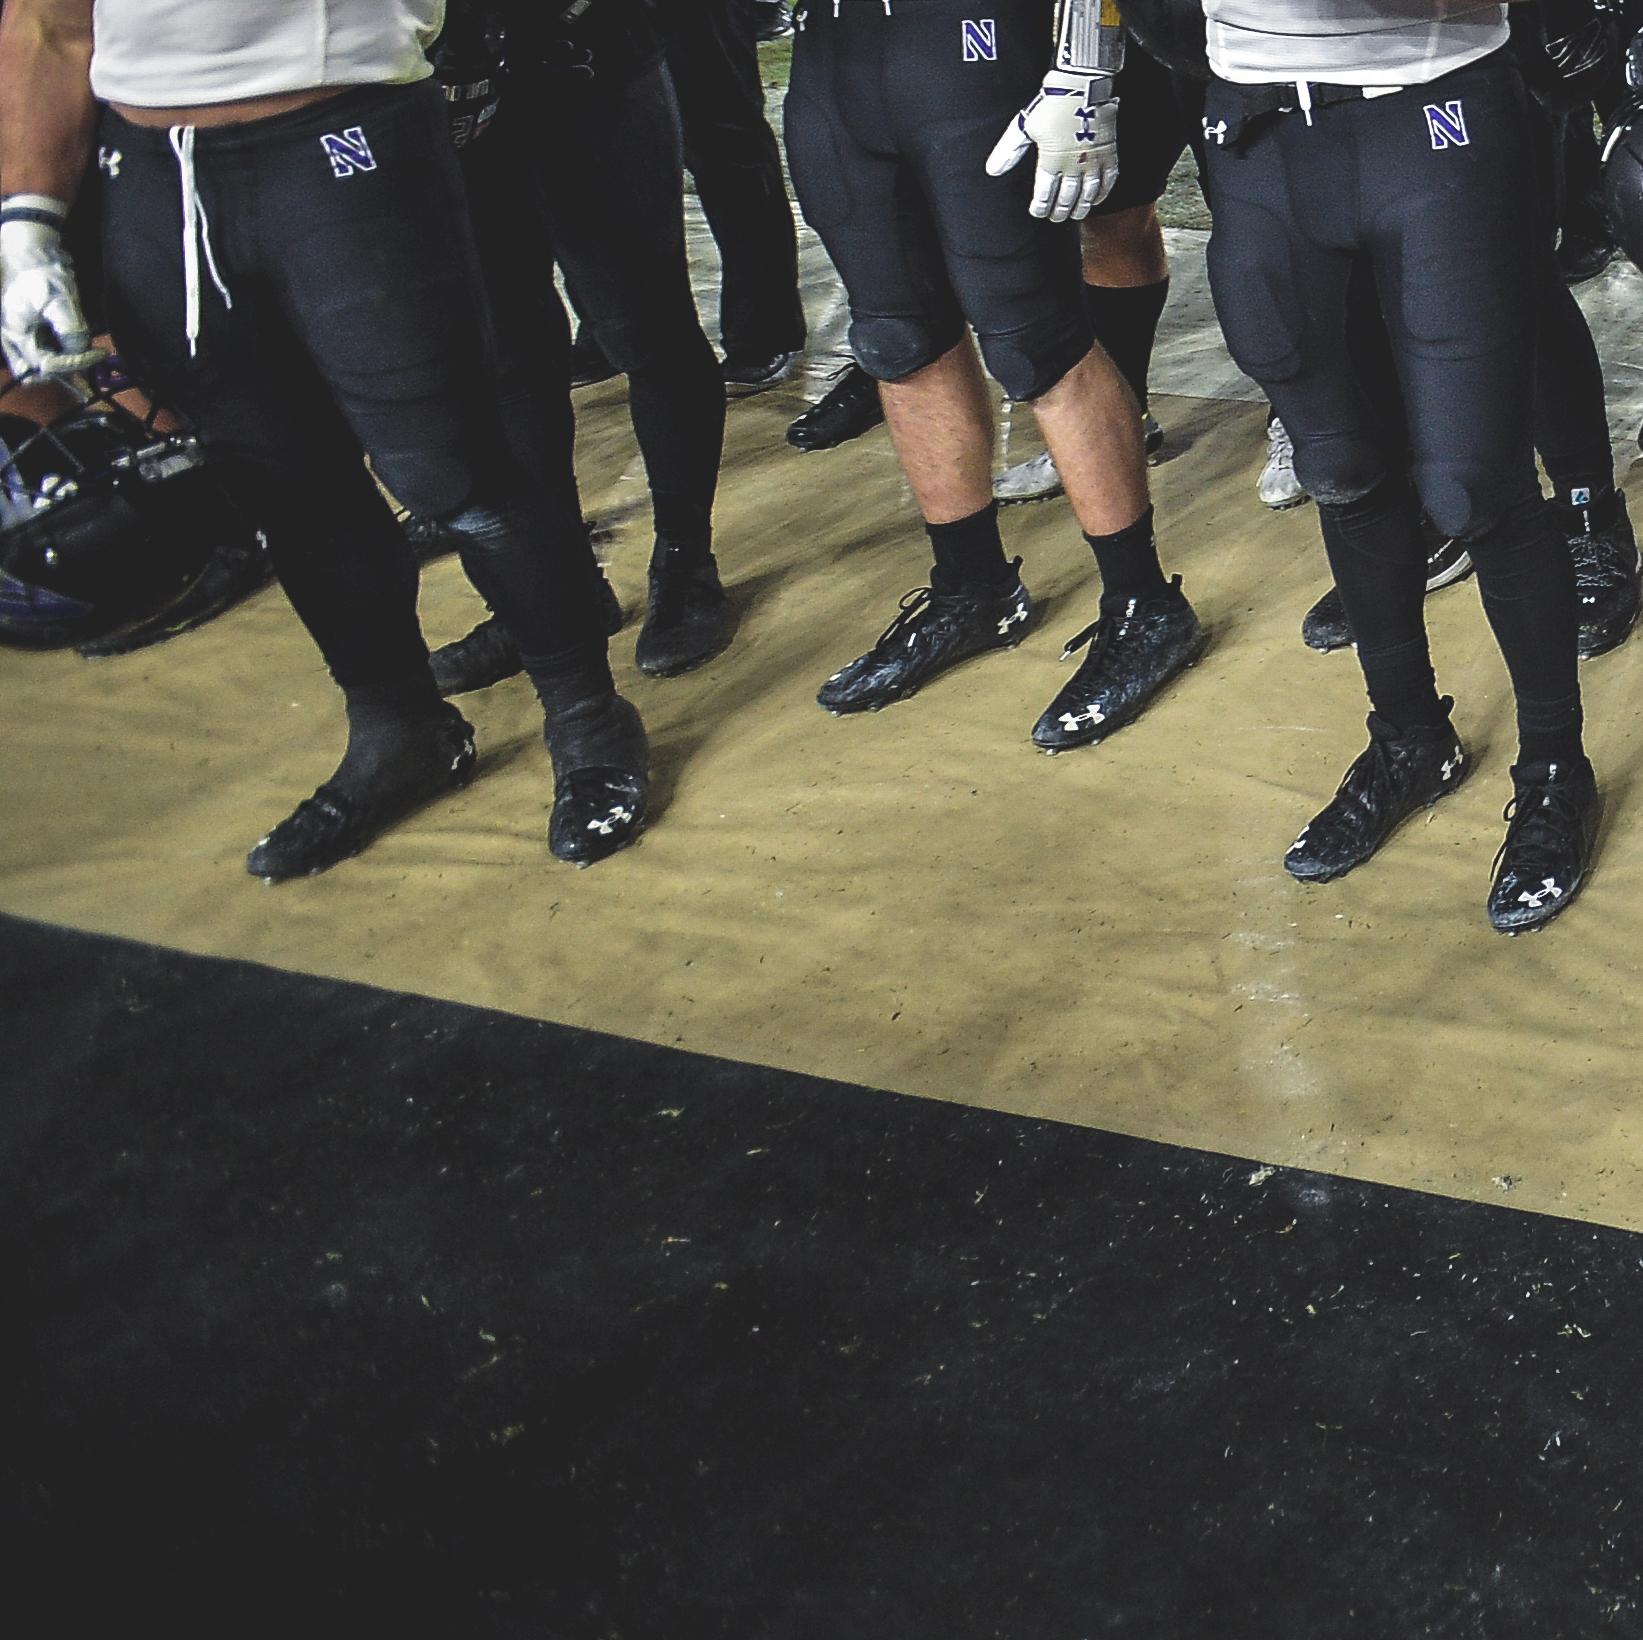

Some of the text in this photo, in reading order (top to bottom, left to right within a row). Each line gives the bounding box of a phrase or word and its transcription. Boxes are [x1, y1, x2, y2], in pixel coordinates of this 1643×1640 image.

[961, 19, 997, 61] N
[1423, 101, 1470, 149] N
[321, 127, 378, 177] N
